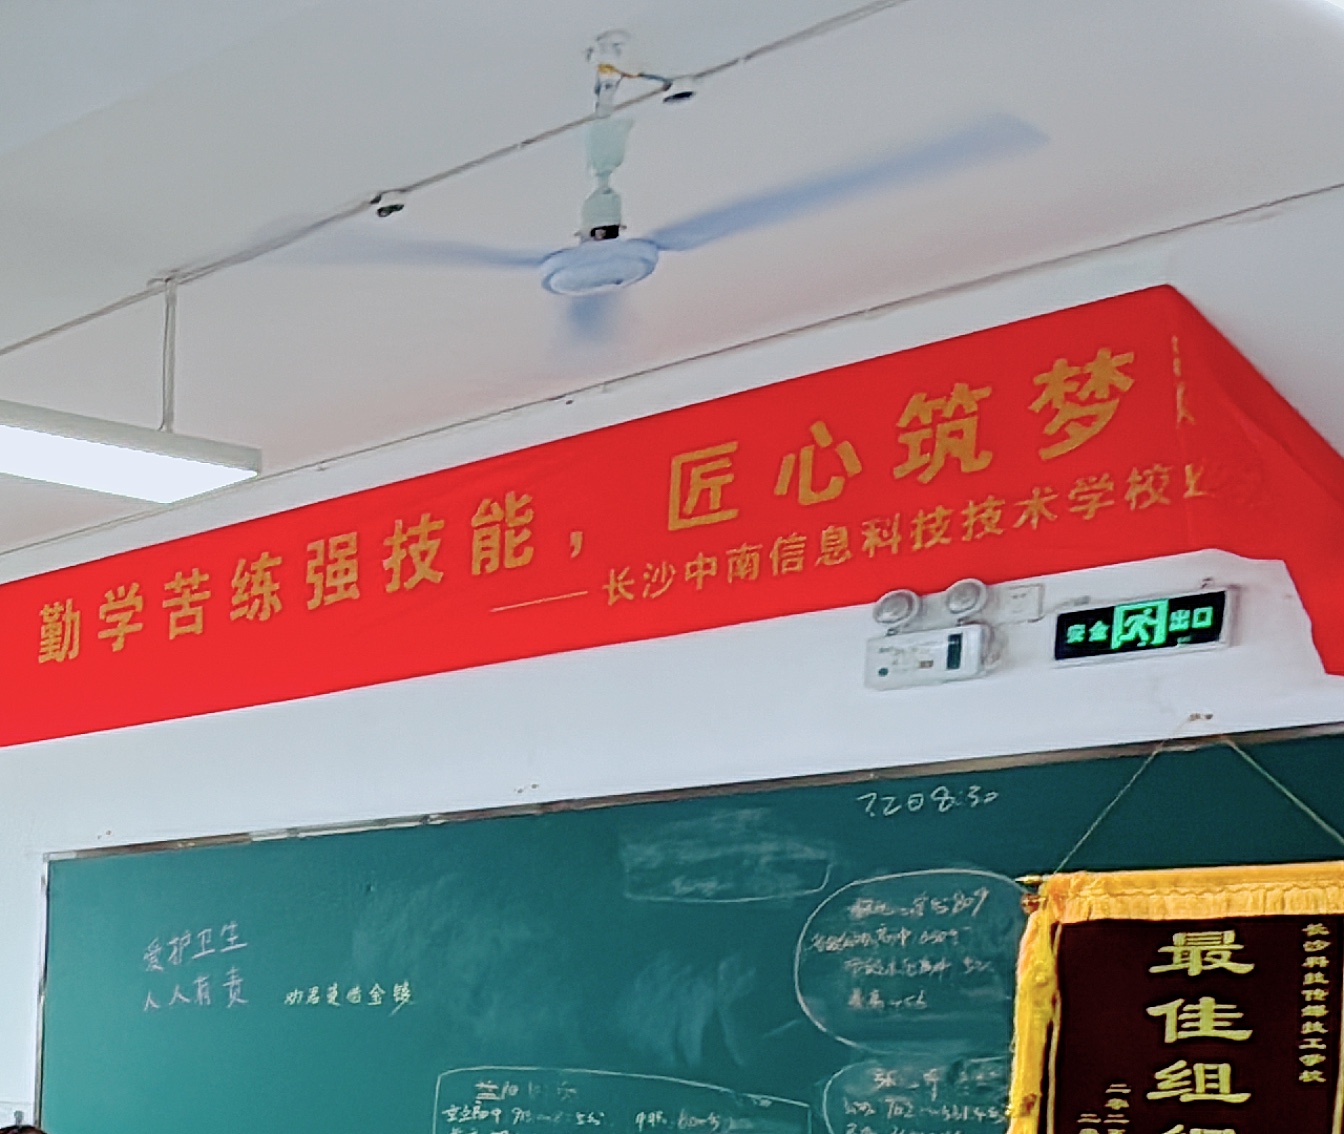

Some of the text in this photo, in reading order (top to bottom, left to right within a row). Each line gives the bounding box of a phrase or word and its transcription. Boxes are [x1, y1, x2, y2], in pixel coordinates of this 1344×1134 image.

[38, 334, 1196, 665] 勤学苦练强技能，匠心筑梦
[1169, 606, 1213, 632] 出口
[143, 966, 249, 1011] 人人有责
